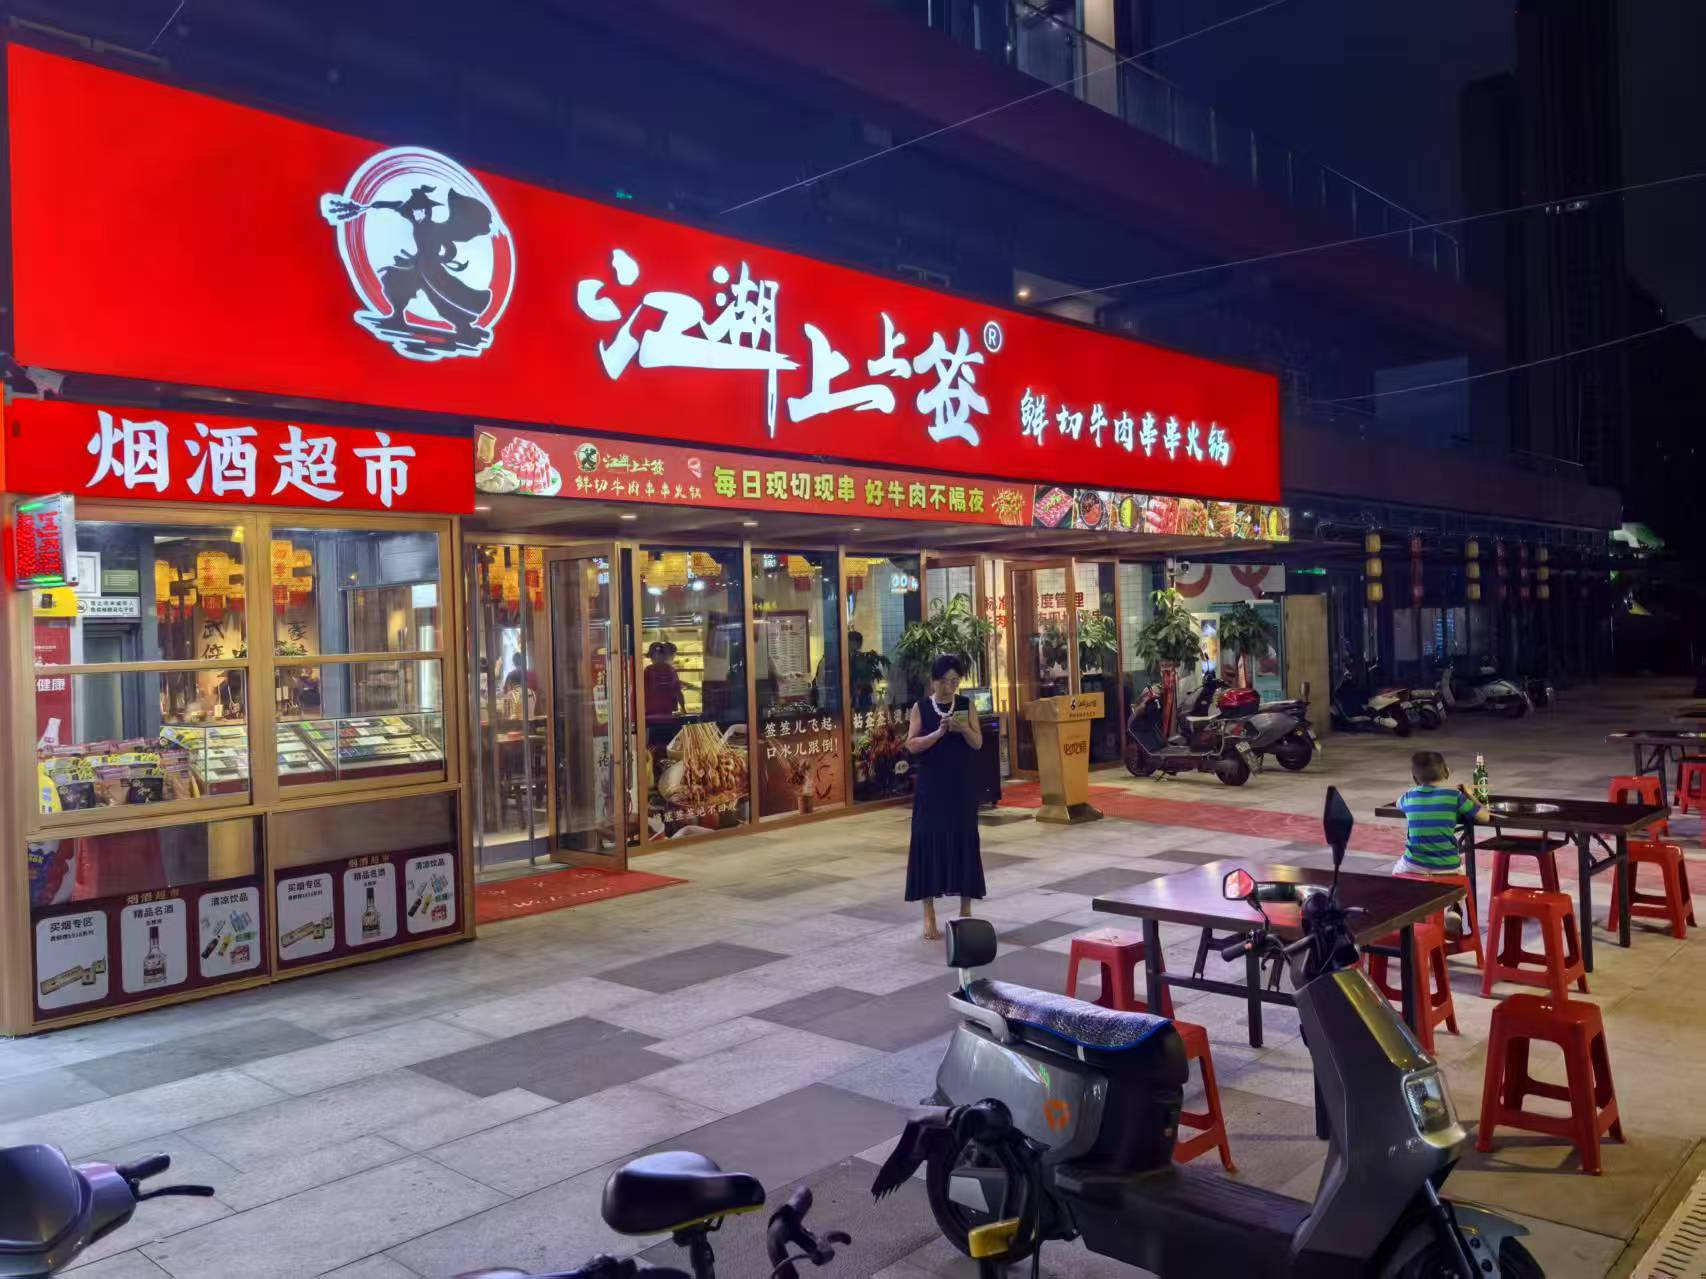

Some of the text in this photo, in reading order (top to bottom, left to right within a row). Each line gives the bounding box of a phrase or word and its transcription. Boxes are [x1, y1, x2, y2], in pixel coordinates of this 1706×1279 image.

[1019, 386, 1231, 468] 鲜切牛肉串串火锅
[86, 410, 416, 508] 烟酒超市
[575, 475, 703, 501] 鲜切牛肉串串火锅
[713, 466, 856, 502] 每日现切现串
[865, 480, 985, 514] 好牛肉不隔夜
[50, 916, 94, 933] 买烟专区
